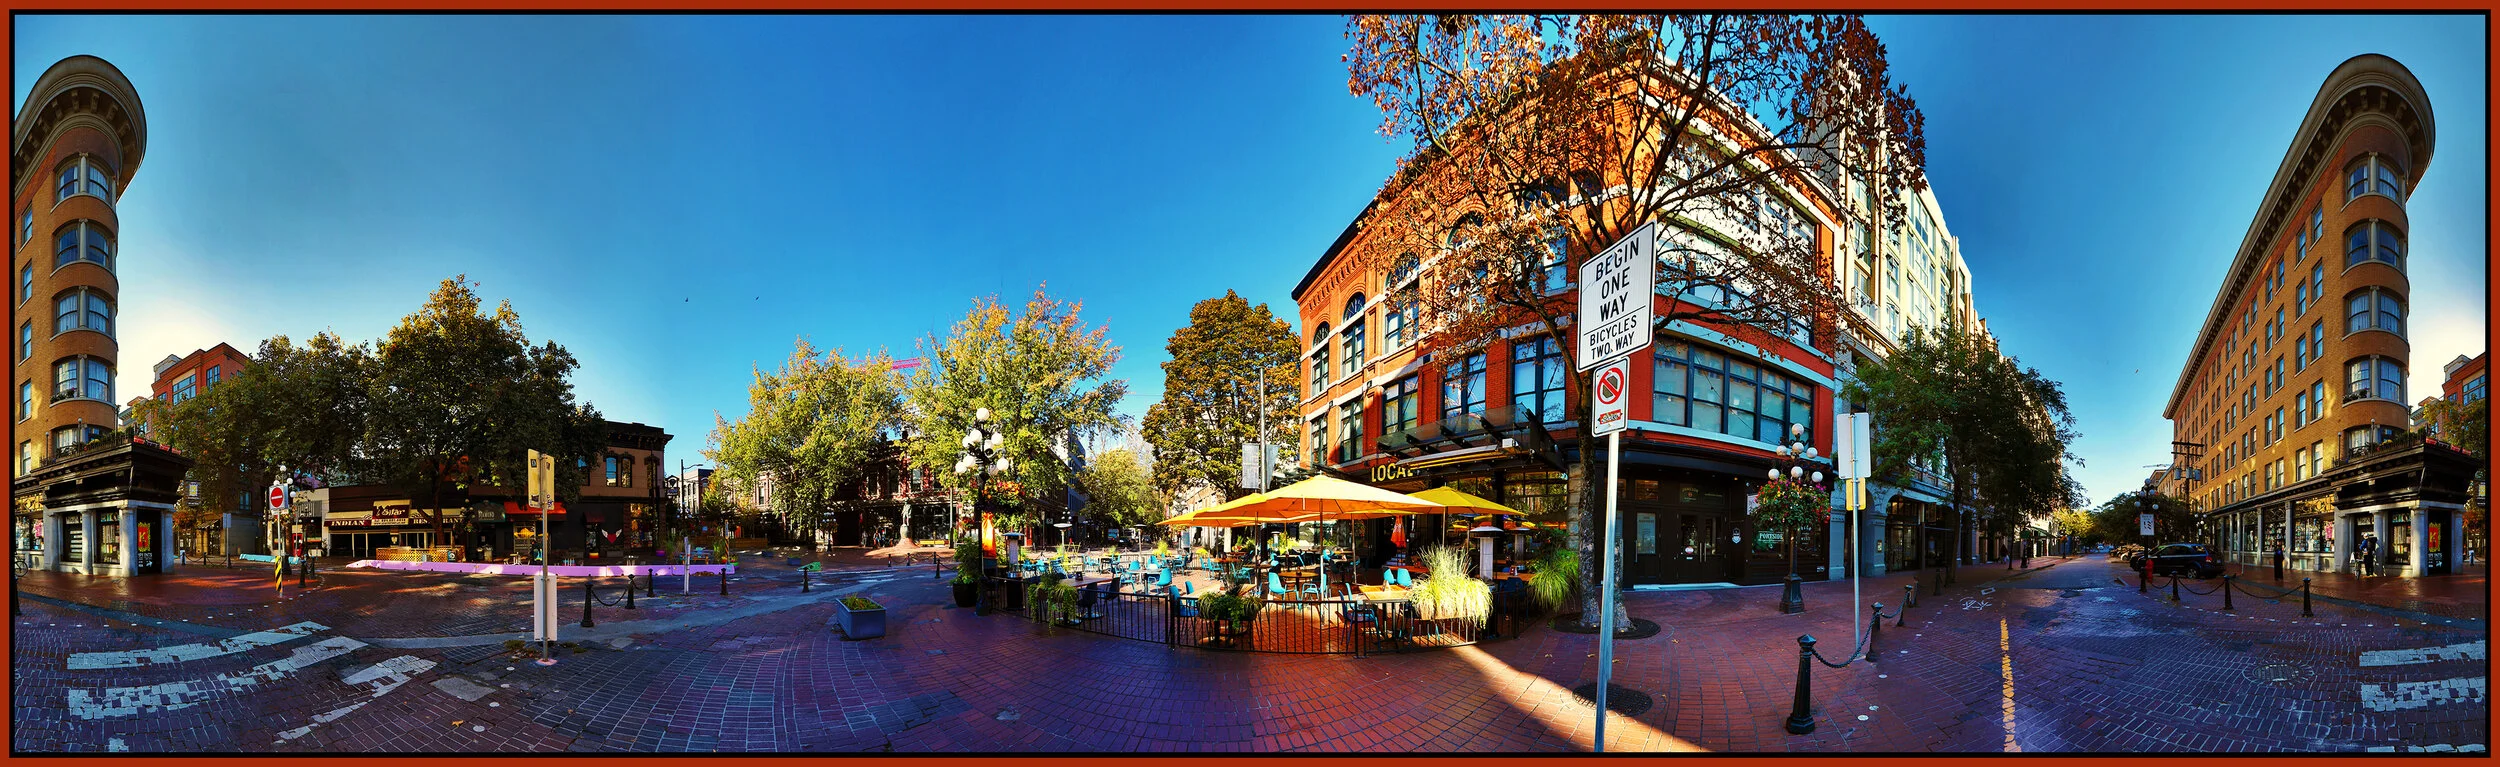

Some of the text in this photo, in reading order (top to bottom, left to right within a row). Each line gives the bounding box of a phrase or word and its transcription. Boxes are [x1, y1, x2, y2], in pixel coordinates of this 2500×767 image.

[1596, 237, 1639, 282] BEGIN
[1602, 267, 1630, 299] ONE
[1600, 292, 1629, 322] WAY
[1590, 315, 1637, 346] BICYCLES
[1615, 332, 1635, 353] WAY
